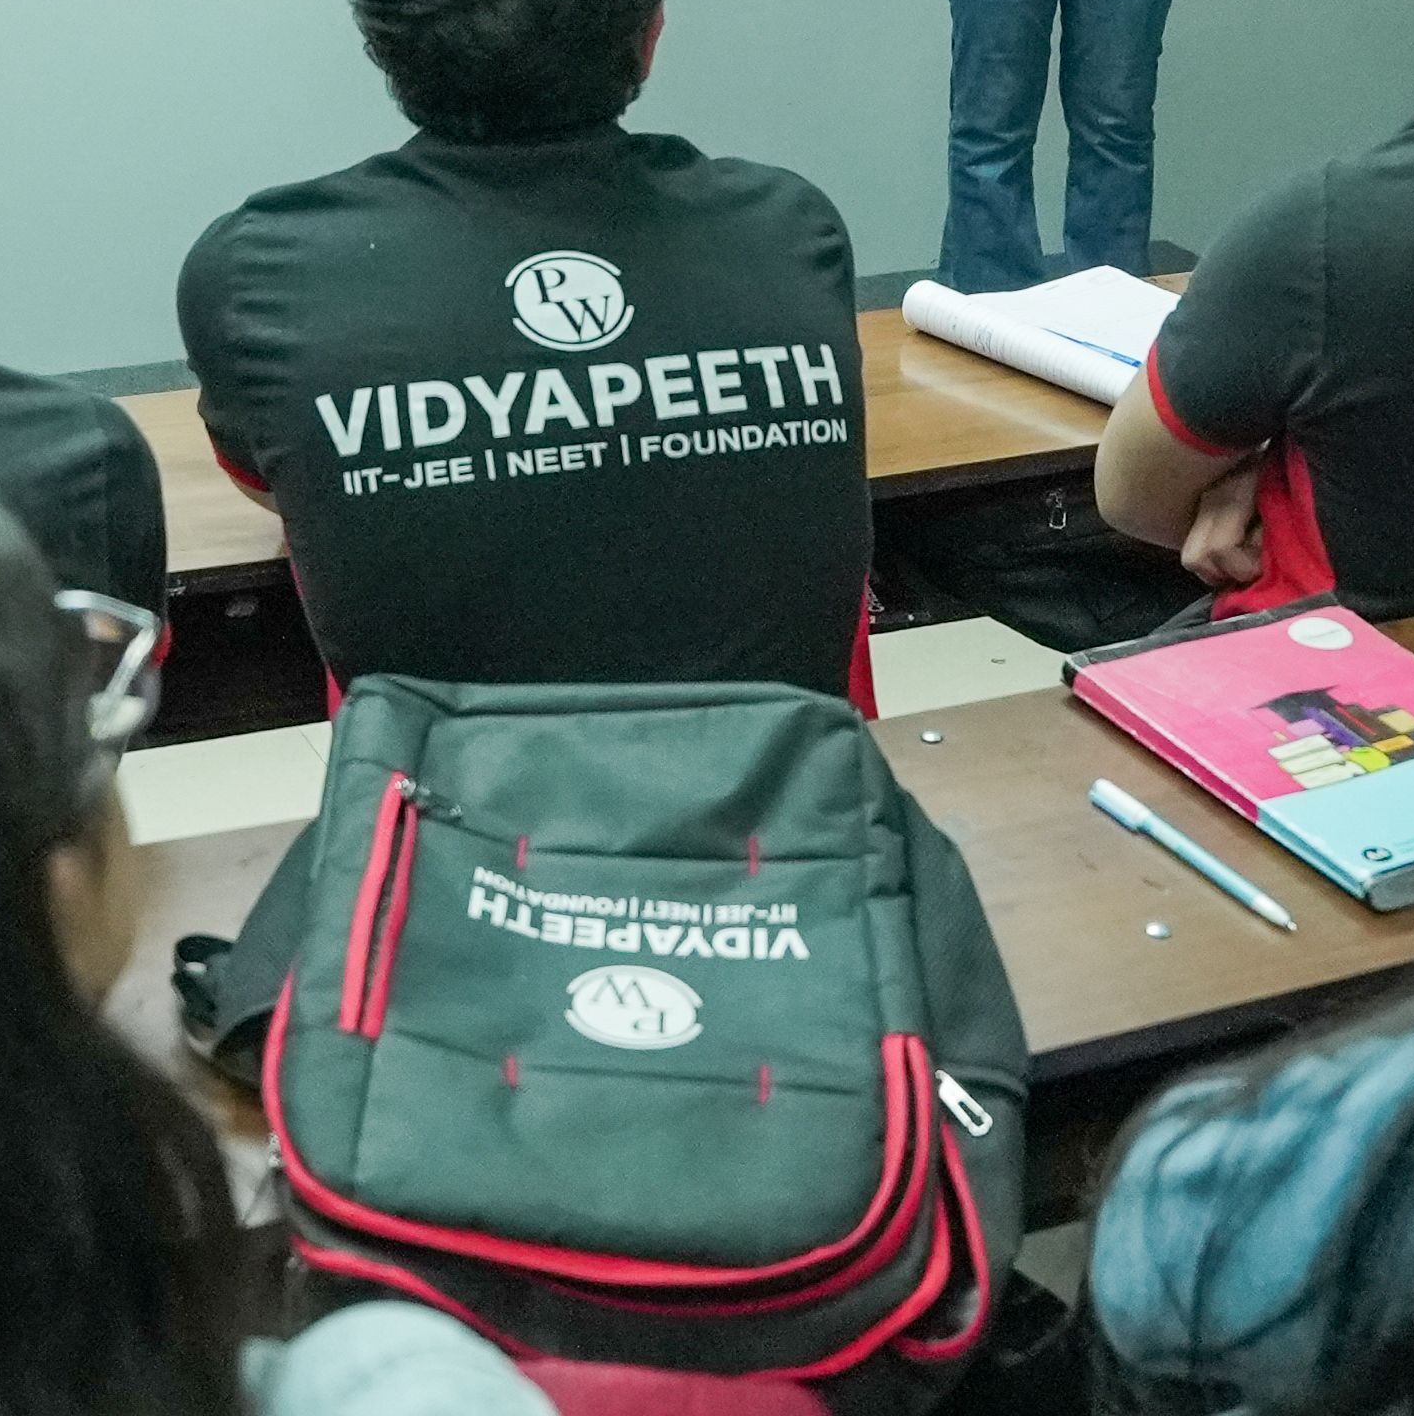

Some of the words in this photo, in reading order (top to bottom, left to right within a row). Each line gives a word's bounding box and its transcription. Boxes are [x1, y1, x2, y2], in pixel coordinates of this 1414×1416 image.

[314, 344, 844, 458] VIDYAPEETH
[342, 455, 474, 497] IIT-JEE
[507, 440, 608, 478] NEET
[640, 418, 848, 463] FOUNDATION
[466, 885, 812, 961] VIDYAPEETH
[473, 866, 628, 918] FOUNDATION
[640, 899, 701, 925] NEET
[714, 903, 798, 926] IIT-JEE
